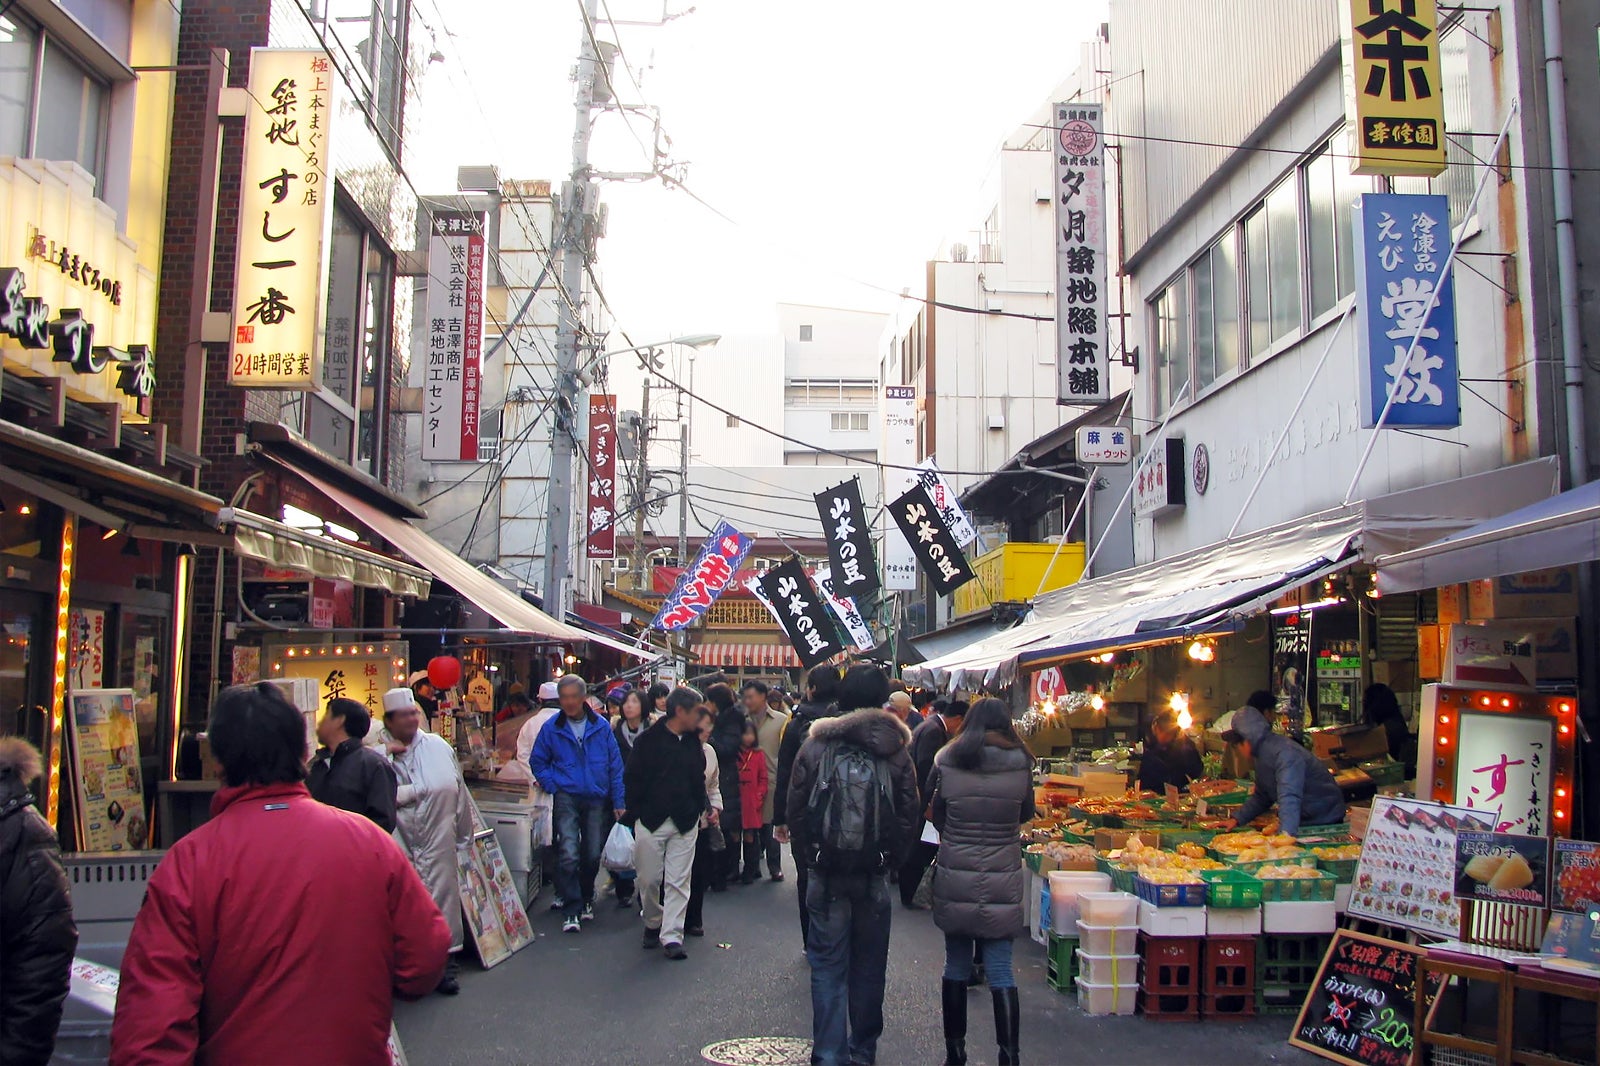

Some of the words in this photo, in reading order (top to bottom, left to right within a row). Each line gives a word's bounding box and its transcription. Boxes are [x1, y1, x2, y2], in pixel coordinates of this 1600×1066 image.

[301, 56, 330, 206] 極上本まぐろの店
[1058, 155, 1100, 167] 株式会社
[435, 217, 484, 233] 吉澤ビル
[1376, 210, 1404, 273] えび
[1410, 211, 1438, 274] 冷凍品
[27, 226, 122, 306] 極上本まぐろの店
[448, 244, 466, 308] 株式会社
[233, 352, 311, 378] 24時間営業
[445, 318, 462, 382] 吉澤商店
[1380, 276, 1444, 407] 堂故
[428, 318, 446, 449] 築地加工センター
[464, 365, 477, 437] 吉澤畜産仕入
[1103, 449, 1128, 460] ウッド
[829, 496, 867, 587] 山本の豆
[906, 502, 961, 584] 山本の豆
[662, 552, 733, 630] まぐろ
[777, 575, 829, 657] 山本の豆
